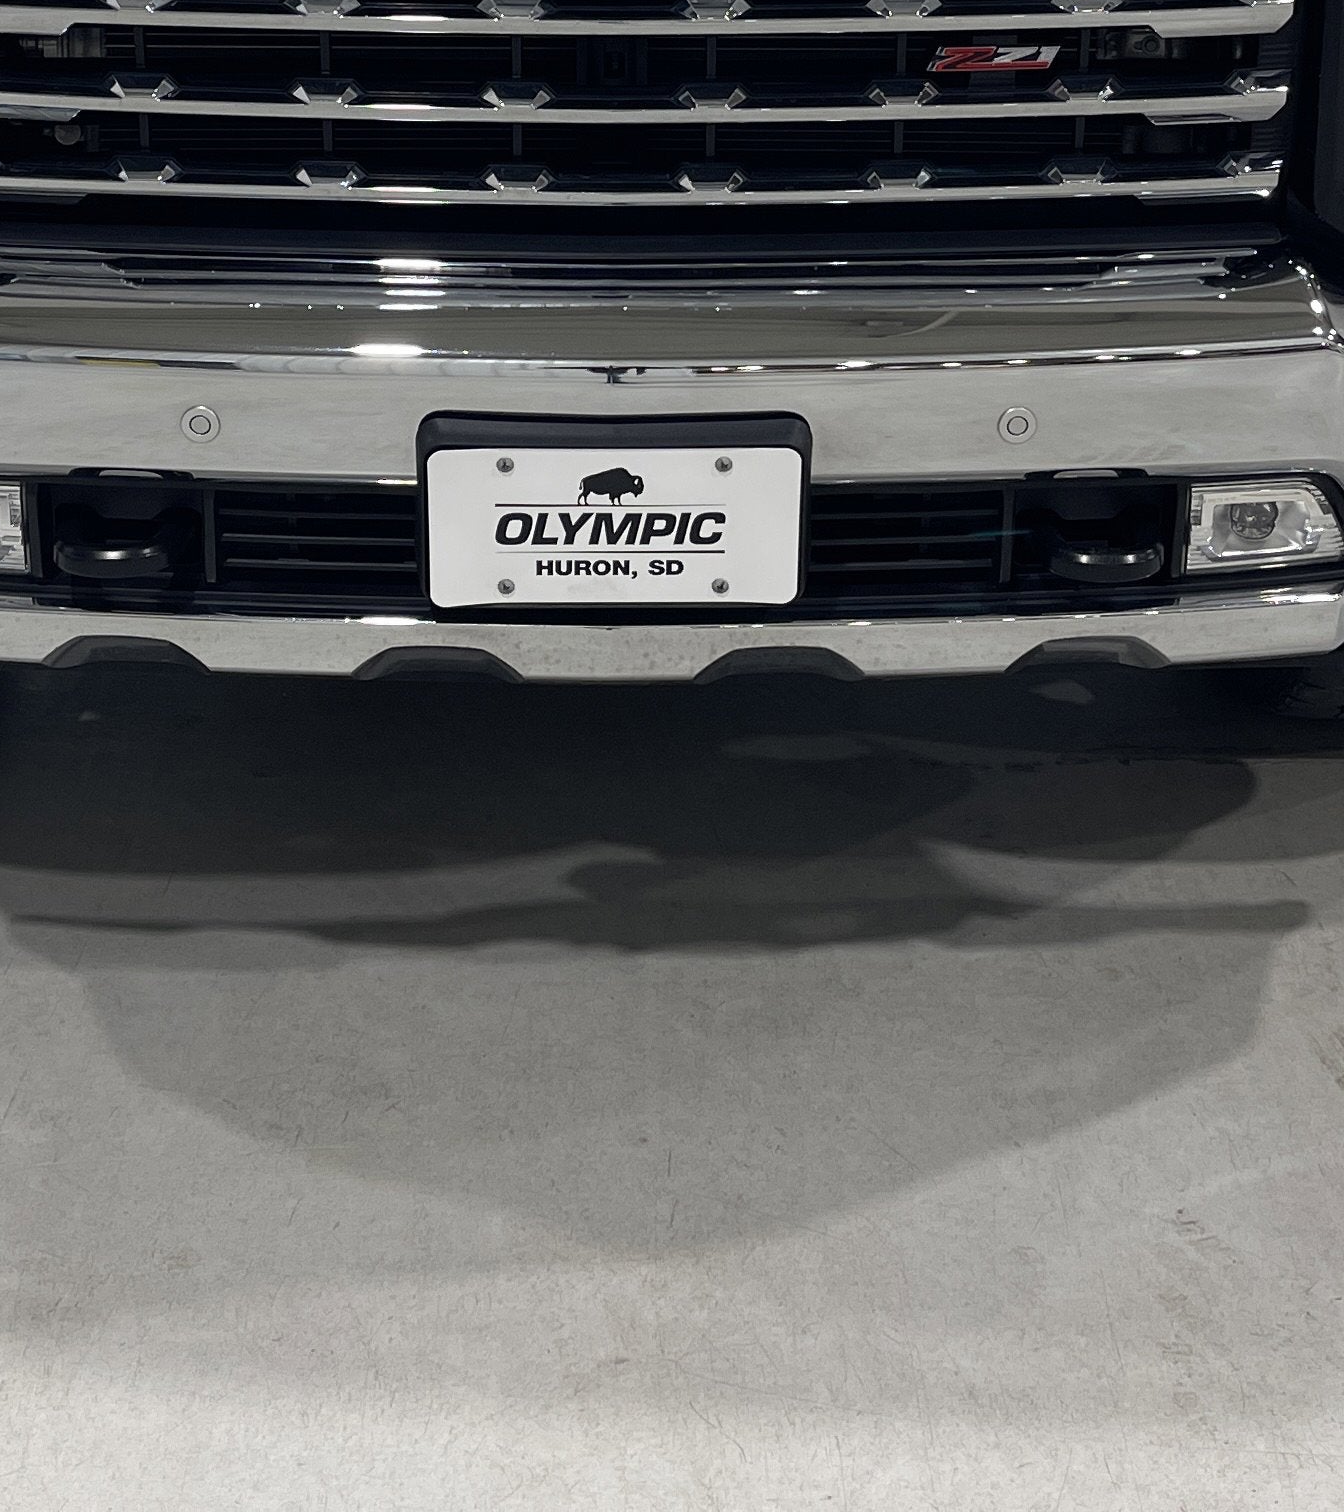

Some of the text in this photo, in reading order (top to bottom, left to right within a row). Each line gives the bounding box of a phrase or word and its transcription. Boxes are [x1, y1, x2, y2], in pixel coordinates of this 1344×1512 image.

[927, 45, 1061, 72] Z71
[494, 511, 727, 546] OLYMPIC
[535, 560, 685, 579] HURON, SD
